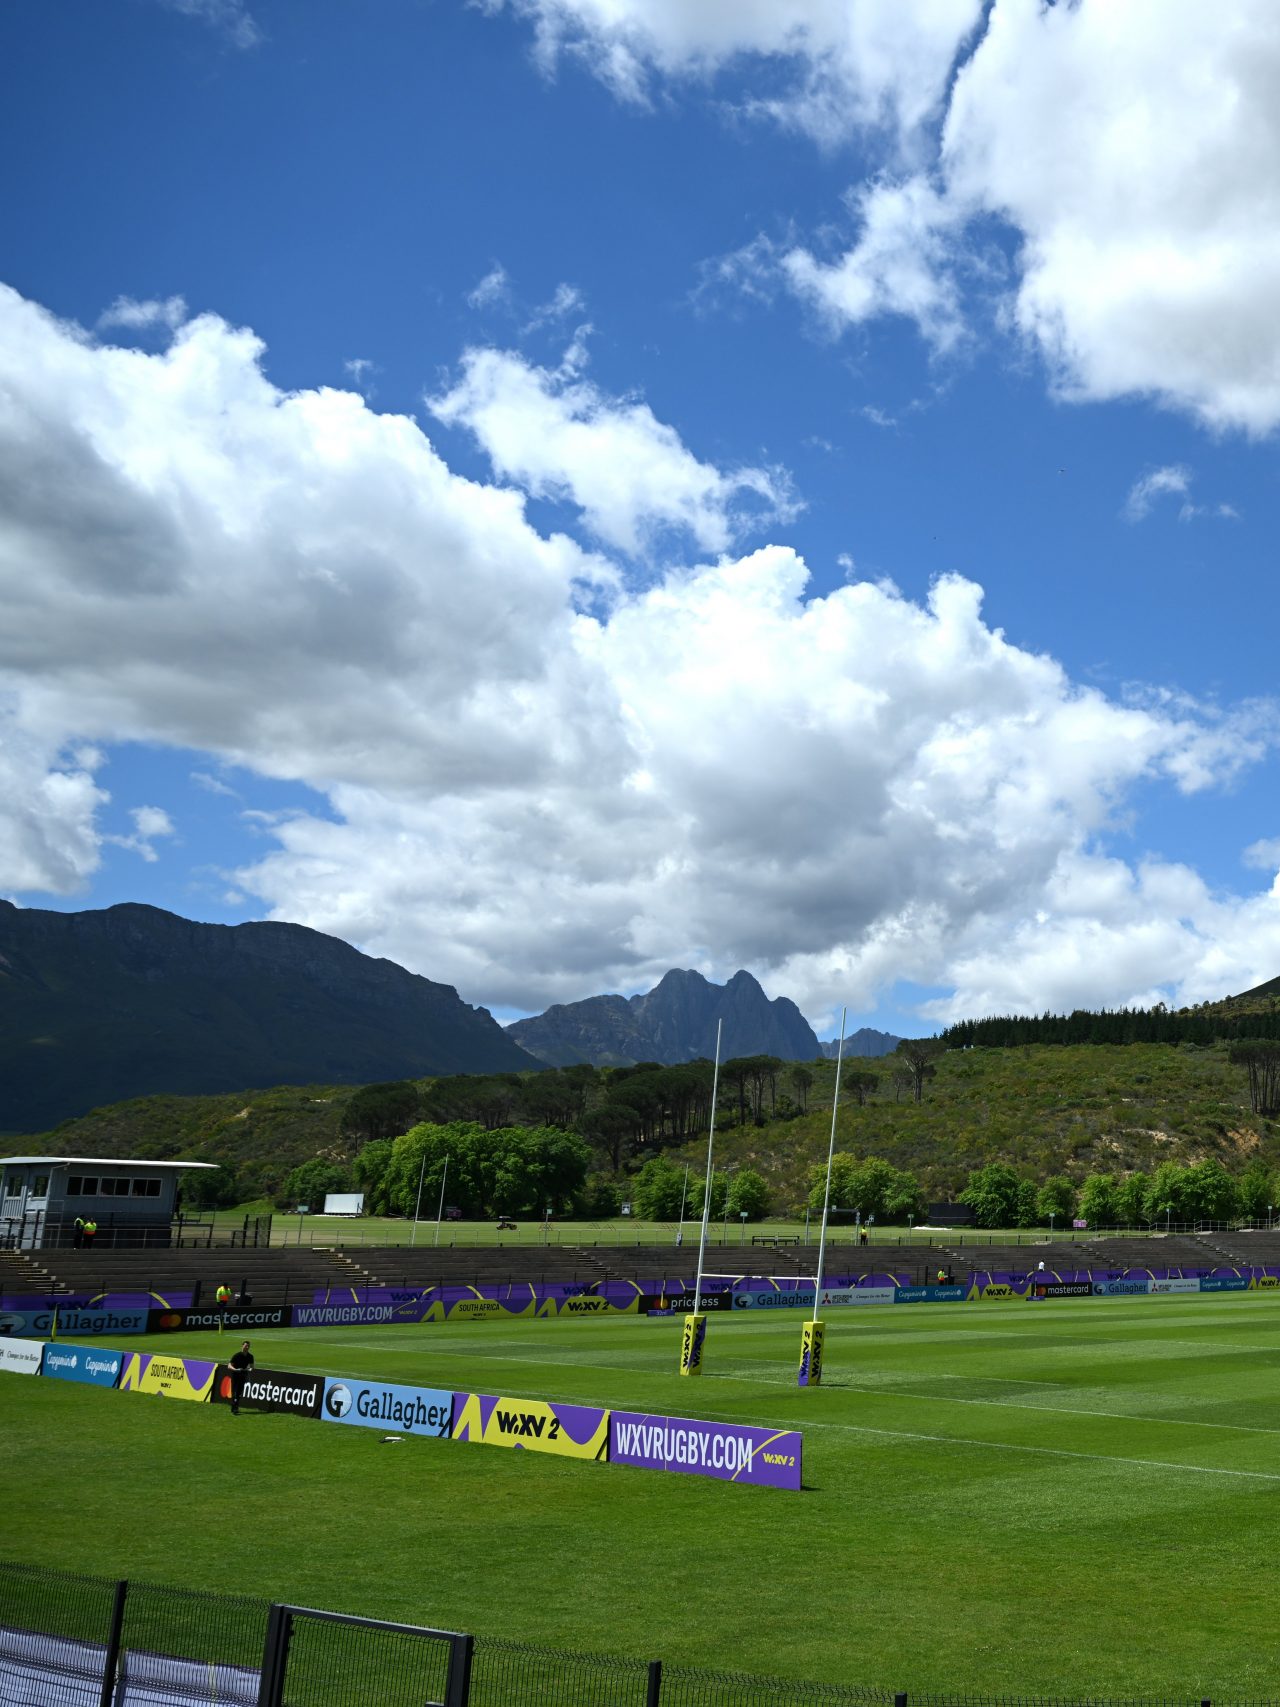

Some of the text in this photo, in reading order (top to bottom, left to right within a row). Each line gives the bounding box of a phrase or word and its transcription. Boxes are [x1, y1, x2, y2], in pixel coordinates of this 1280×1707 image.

[1048, 1284, 1089, 1294] mastercard
[1108, 1283, 1146, 1294] Gallagher
[459, 1303, 500, 1312] SOUTH AFRICA
[757, 1294, 814, 1307] Gallagher
[186, 1310, 282, 1325] mastercard
[297, 1307, 393, 1323] WXVRUGBY.COM
[47, 1352, 71, 1371] Capgemini
[85, 1357, 112, 1376] Capgemini
[151, 1363, 185, 1380] SOUTH AFRICA
[357, 1390, 448, 1429] Gallagher
[616, 1422, 753, 1473] WXVRUGBY.COM
